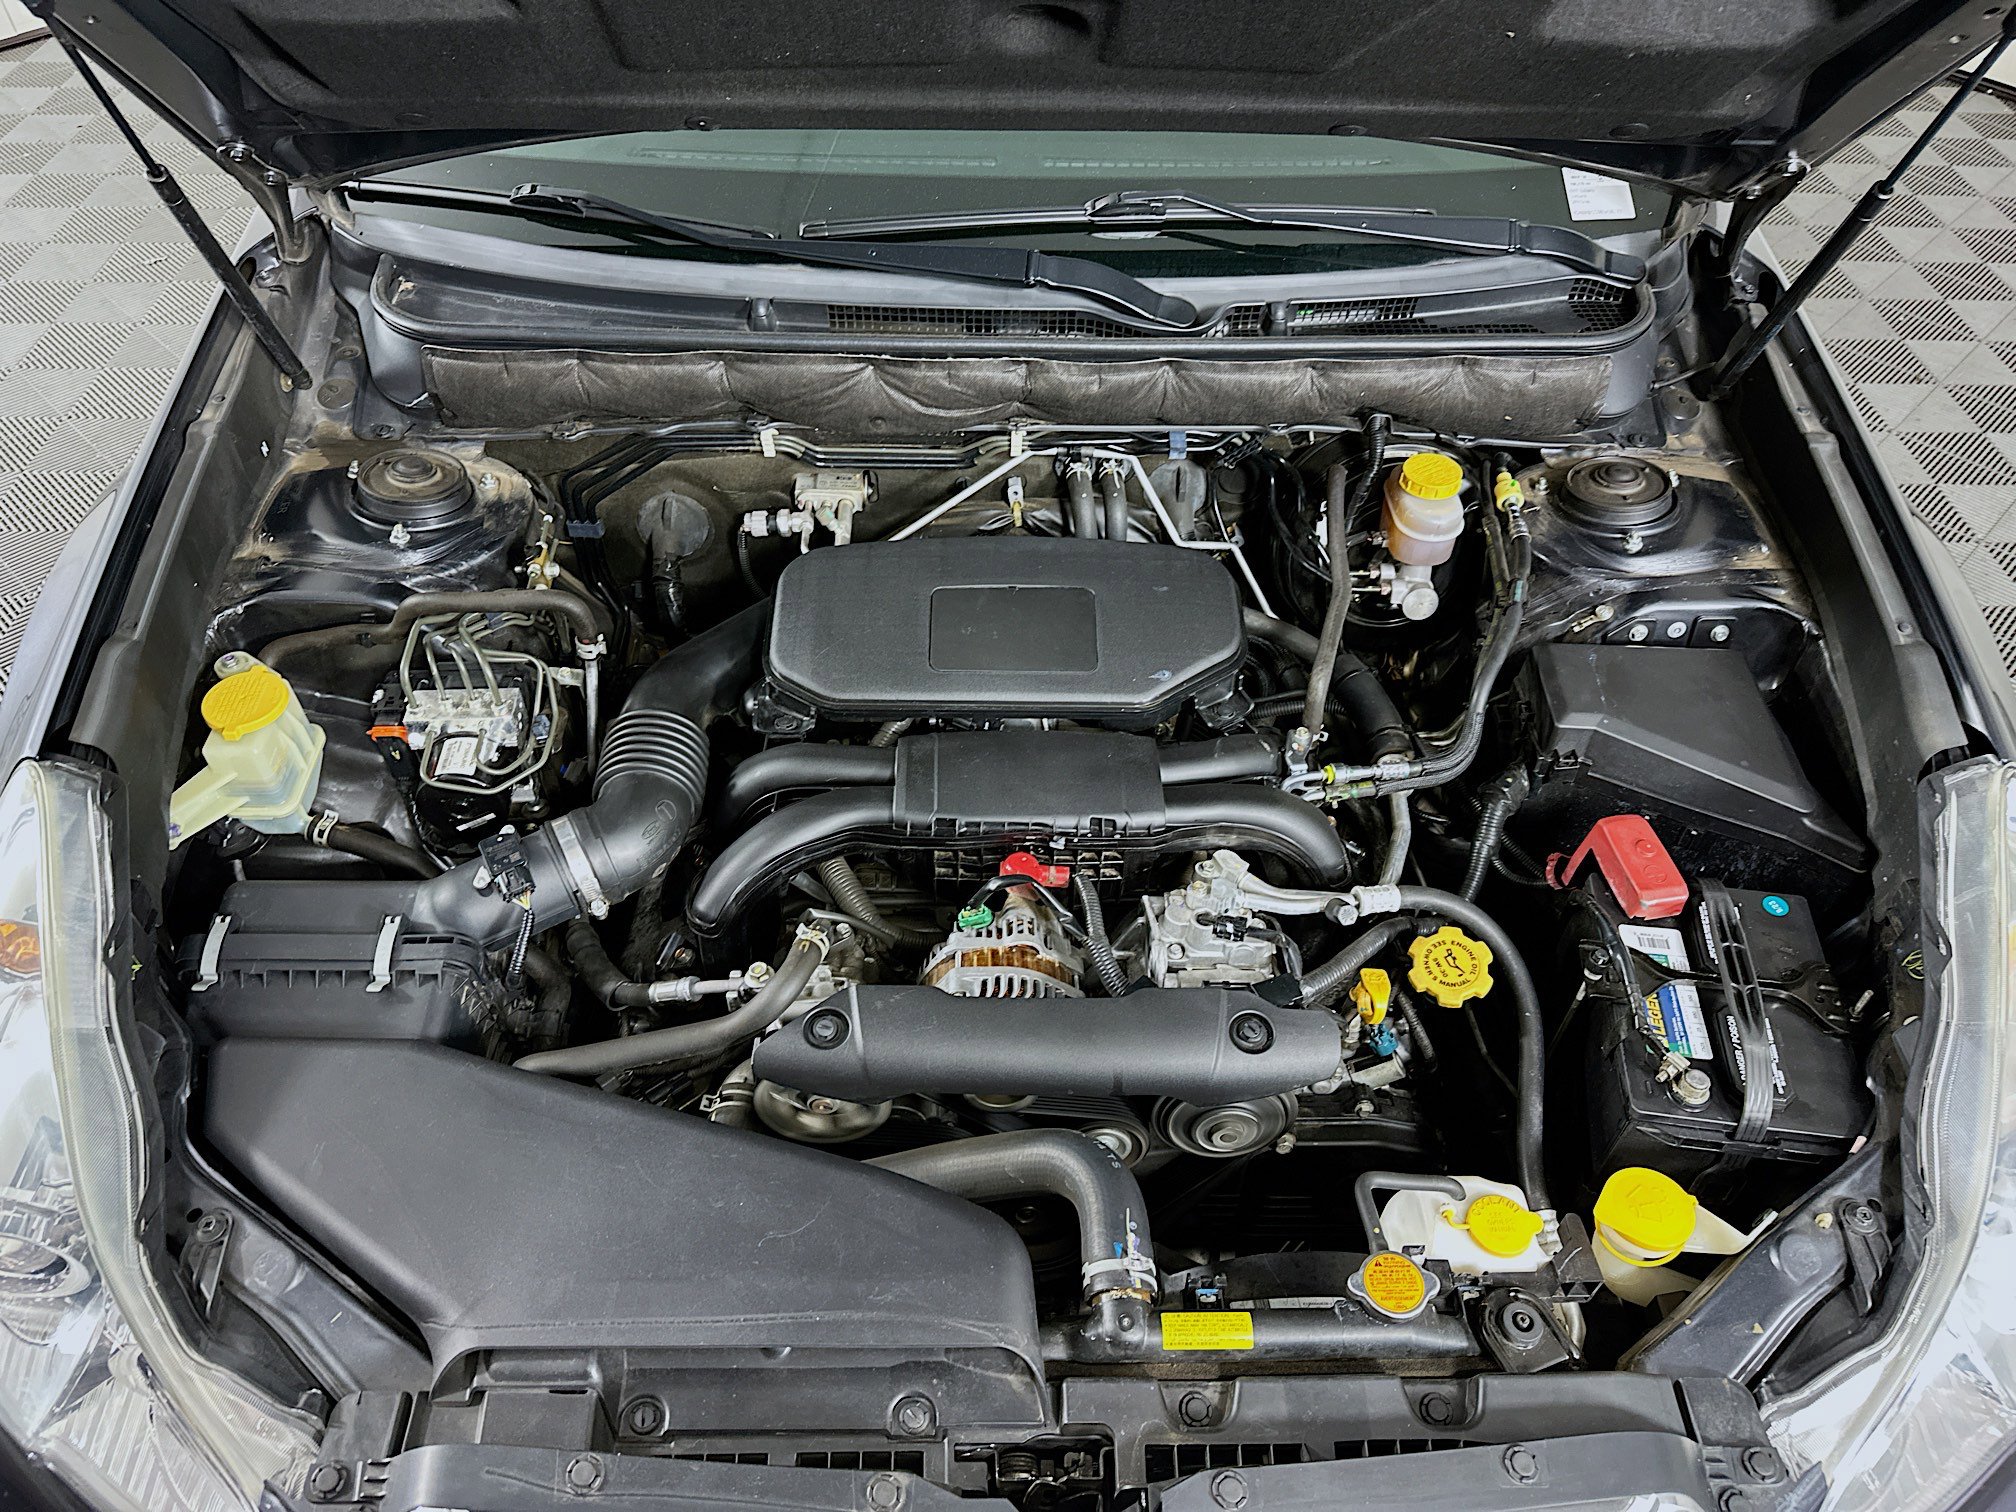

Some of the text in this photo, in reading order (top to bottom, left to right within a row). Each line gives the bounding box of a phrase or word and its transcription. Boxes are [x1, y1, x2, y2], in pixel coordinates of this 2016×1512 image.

[1432, 940, 1446, 949] SEE
[1439, 978, 1471, 987] MANUAL
[1451, 941, 1476, 961] ENGINE
[1646, 993, 1666, 1035] LEGEN
[1726, 1015, 1741, 1044] POISON
[1471, 1196, 1520, 1216] COOLANT
